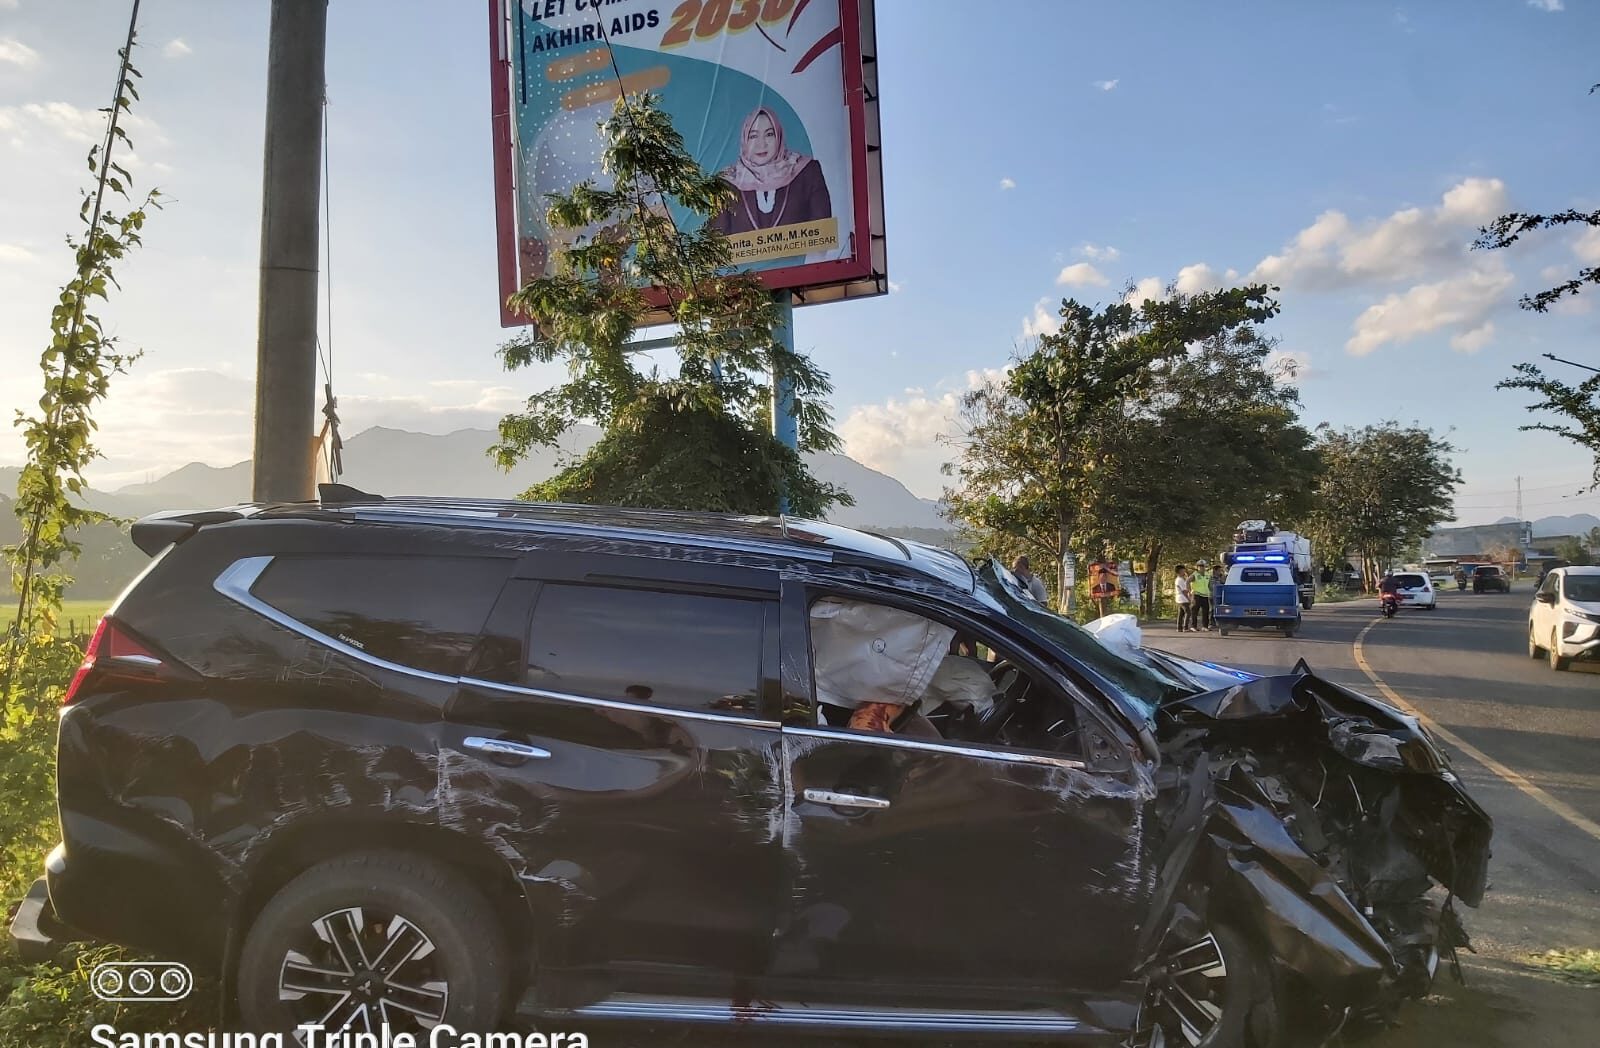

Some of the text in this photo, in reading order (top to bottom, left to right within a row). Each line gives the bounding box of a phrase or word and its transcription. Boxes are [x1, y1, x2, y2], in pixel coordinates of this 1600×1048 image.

[531, 0, 567, 21] LET
[532, 9, 660, 53] AKHIRI AIDS
[726, 239, 754, 250] Anita,
[735, 235, 836, 258] KESEHATAN ACEH BESAR
